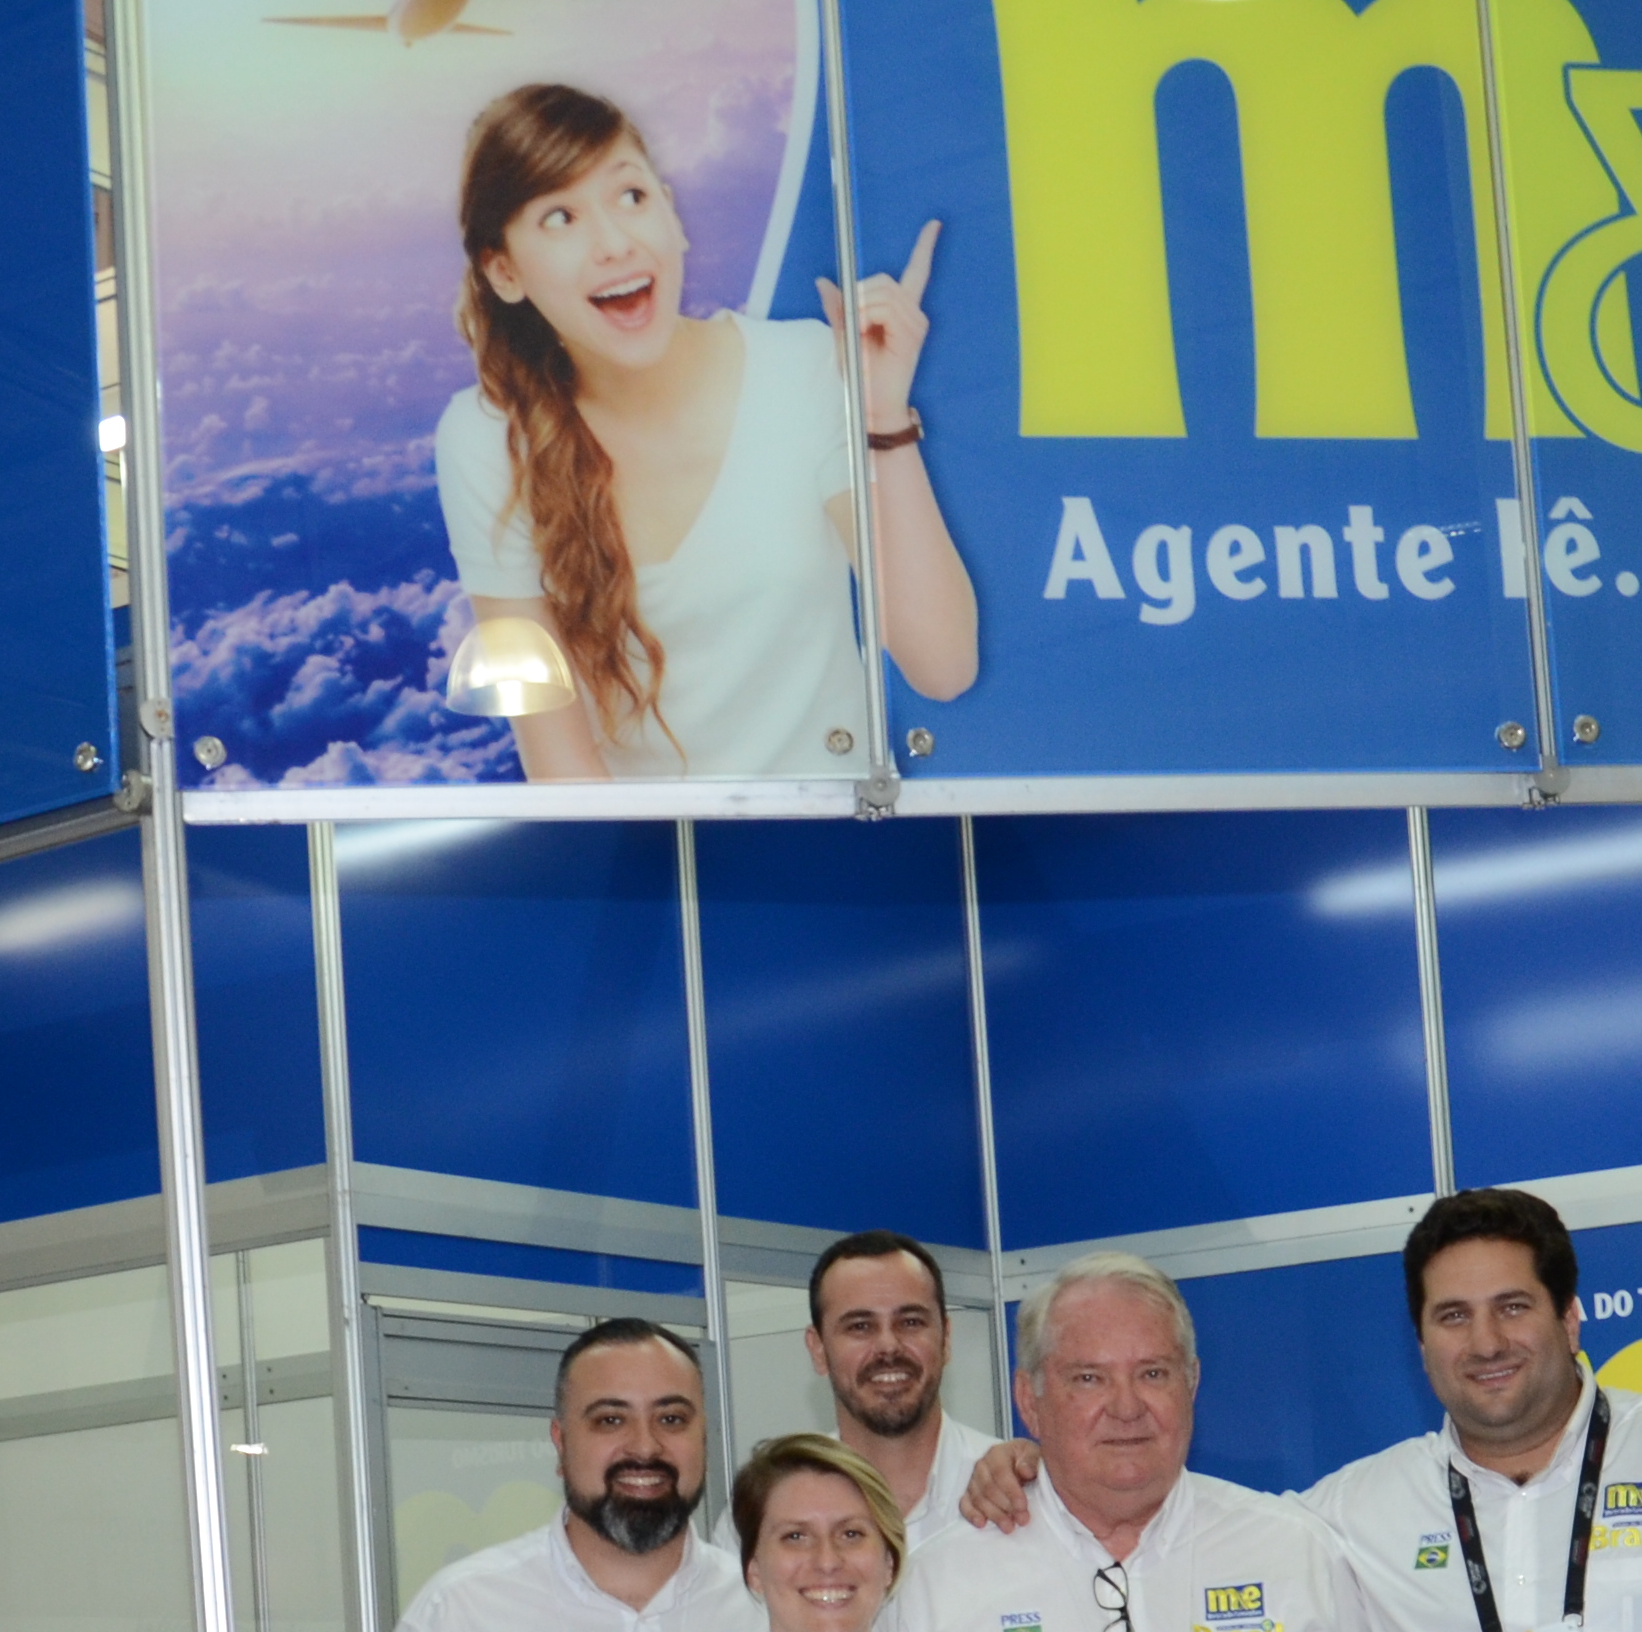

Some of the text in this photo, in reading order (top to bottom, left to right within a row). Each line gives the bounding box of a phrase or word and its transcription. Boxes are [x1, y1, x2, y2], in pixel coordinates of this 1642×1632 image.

[1043, 497, 1455, 625] Agente
[1593, 1289, 1634, 1320] DO
[1421, 1531, 1453, 1544] PRESS
[1000, 1612, 1042, 1626] PRESS
